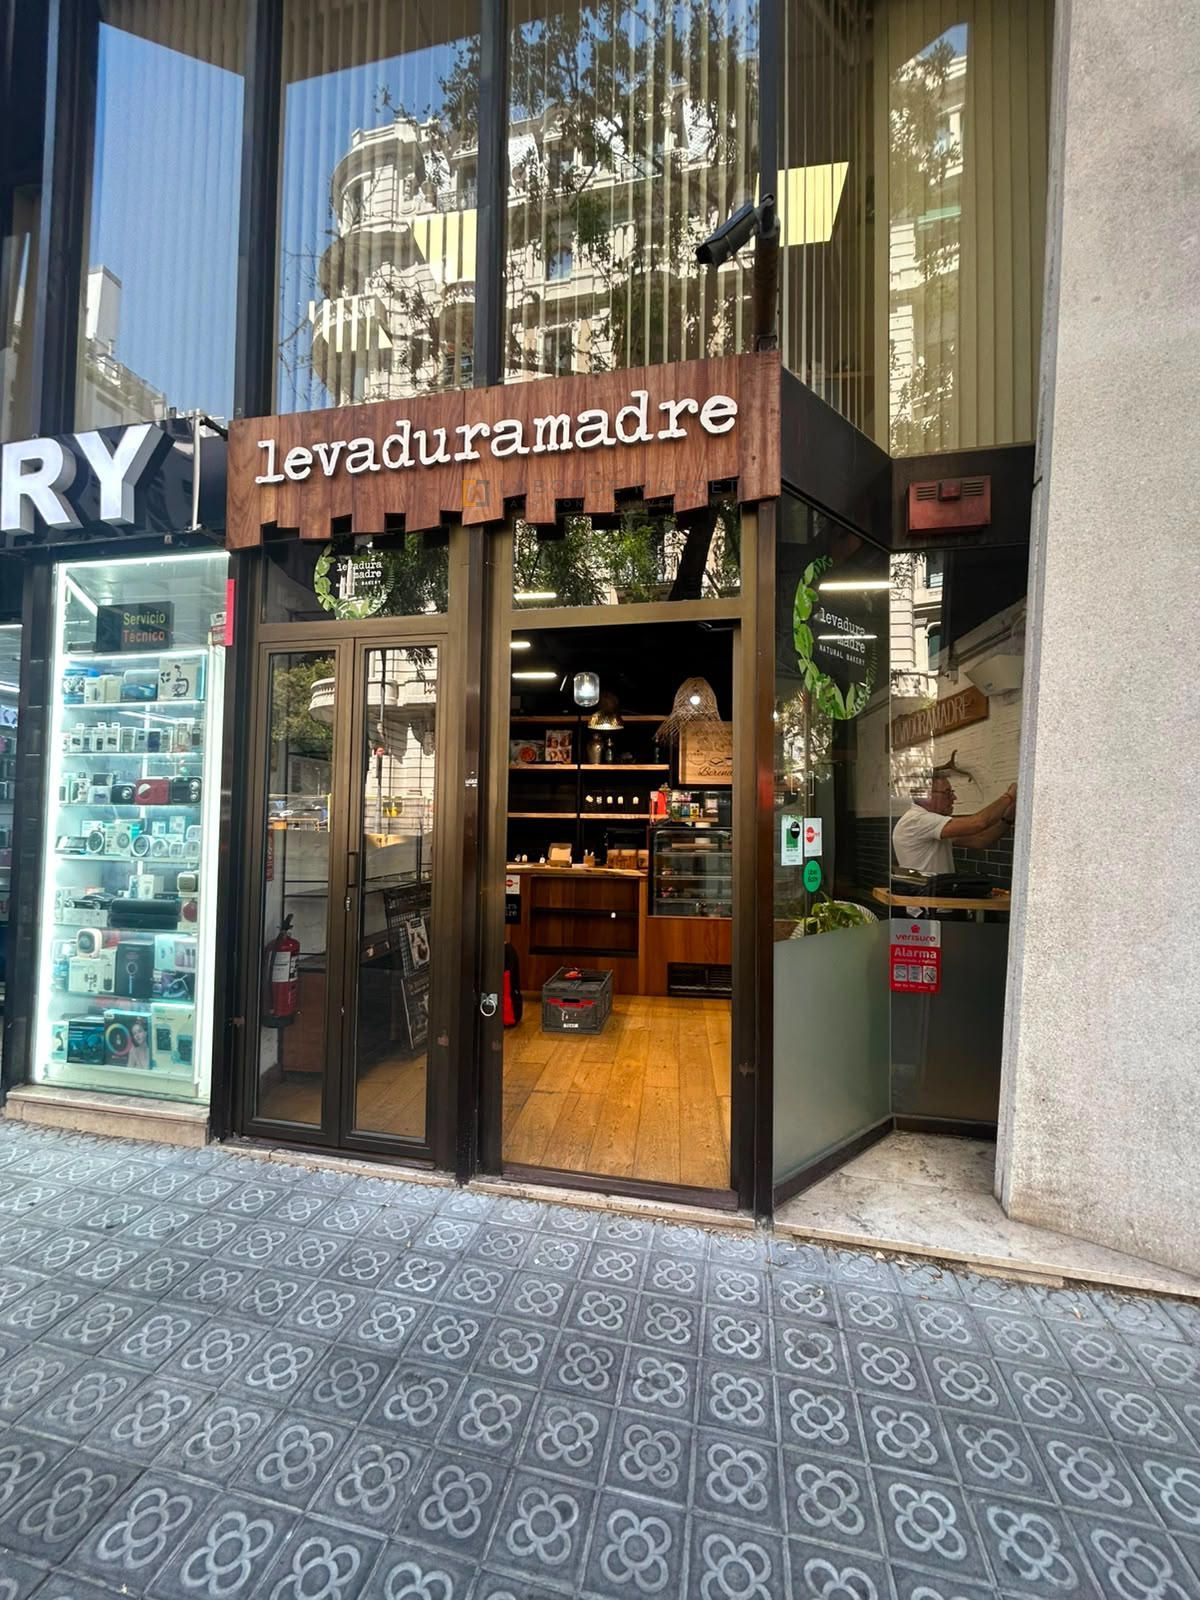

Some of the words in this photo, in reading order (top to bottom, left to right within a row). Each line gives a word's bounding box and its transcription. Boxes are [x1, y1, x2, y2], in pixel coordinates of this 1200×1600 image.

[255, 390, 738, 484] levaduramadre
[1, 424, 160, 534] RY
[336, 561, 383, 571] leadura
[123, 610, 166, 626] Servicio
[819, 607, 866, 636] levadura
[895, 934, 937, 943] verisure
[894, 946, 937, 959] Alarma
